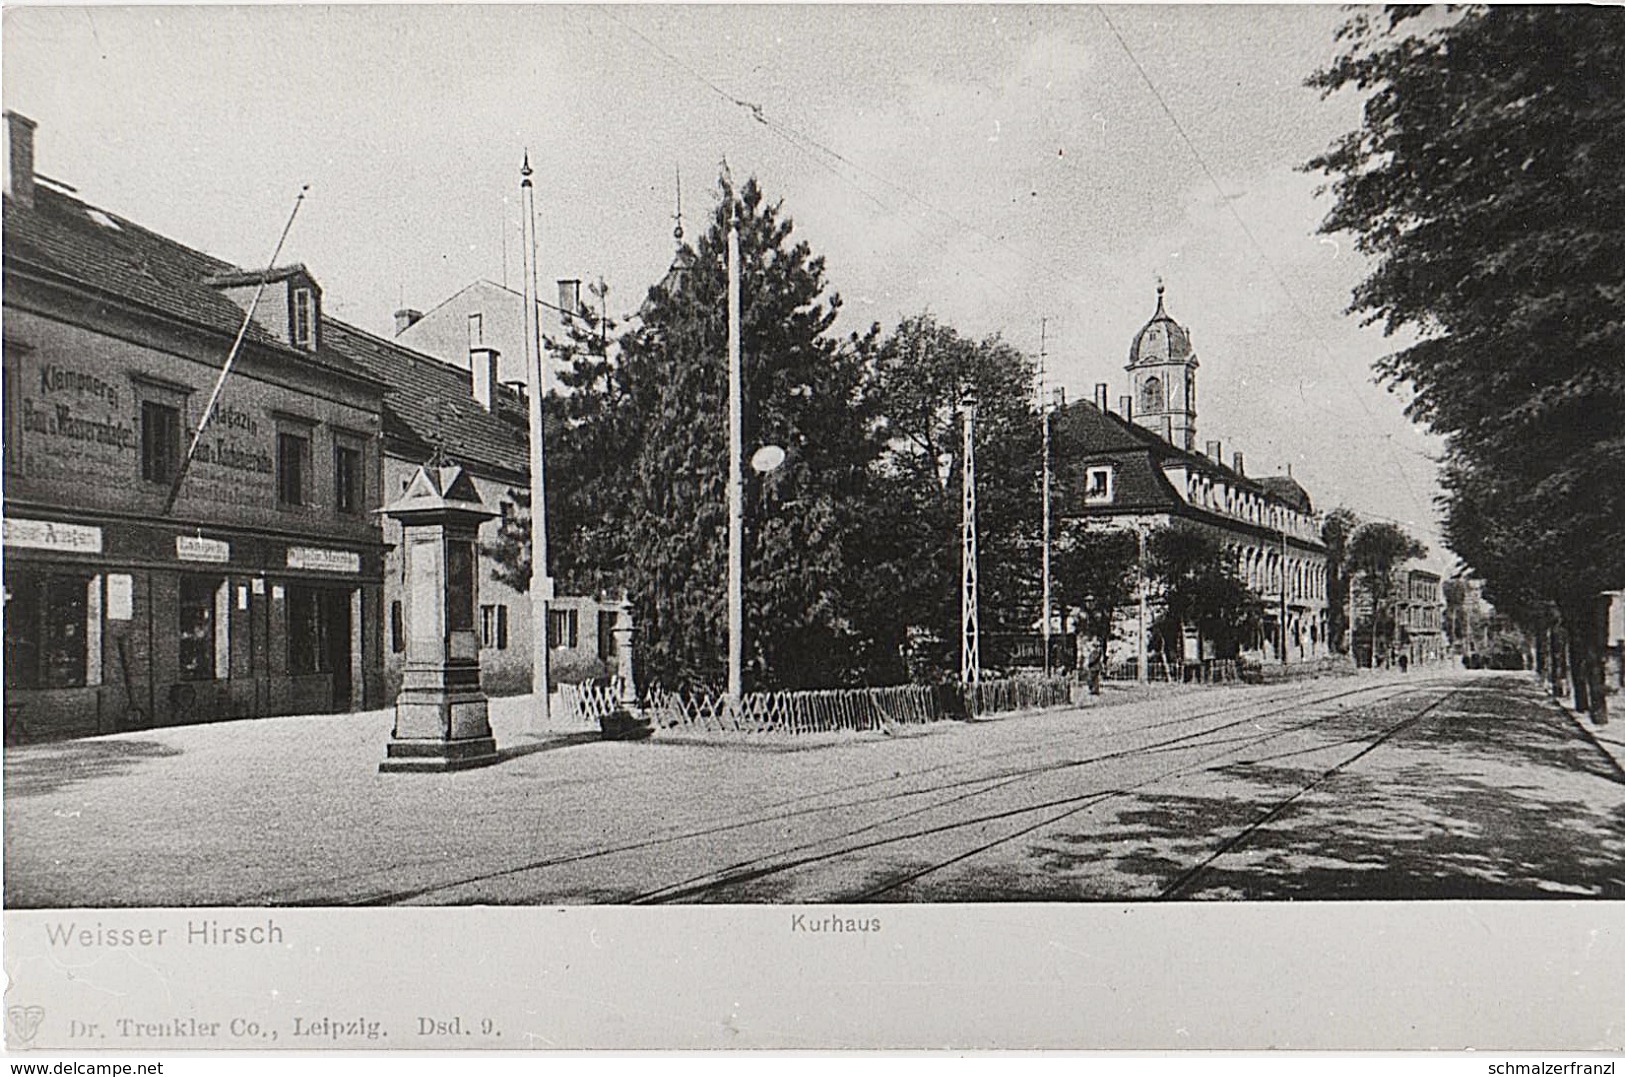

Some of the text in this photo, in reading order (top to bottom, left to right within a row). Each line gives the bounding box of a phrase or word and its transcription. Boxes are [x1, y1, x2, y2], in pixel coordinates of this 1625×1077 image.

[46, 919, 283, 947] Weisser Hirsch
[792, 914, 881, 932] Kurhaus
[69, 1017, 501, 1041] Dr. Trenkler Co., Leipzig. Dsd. 9.
